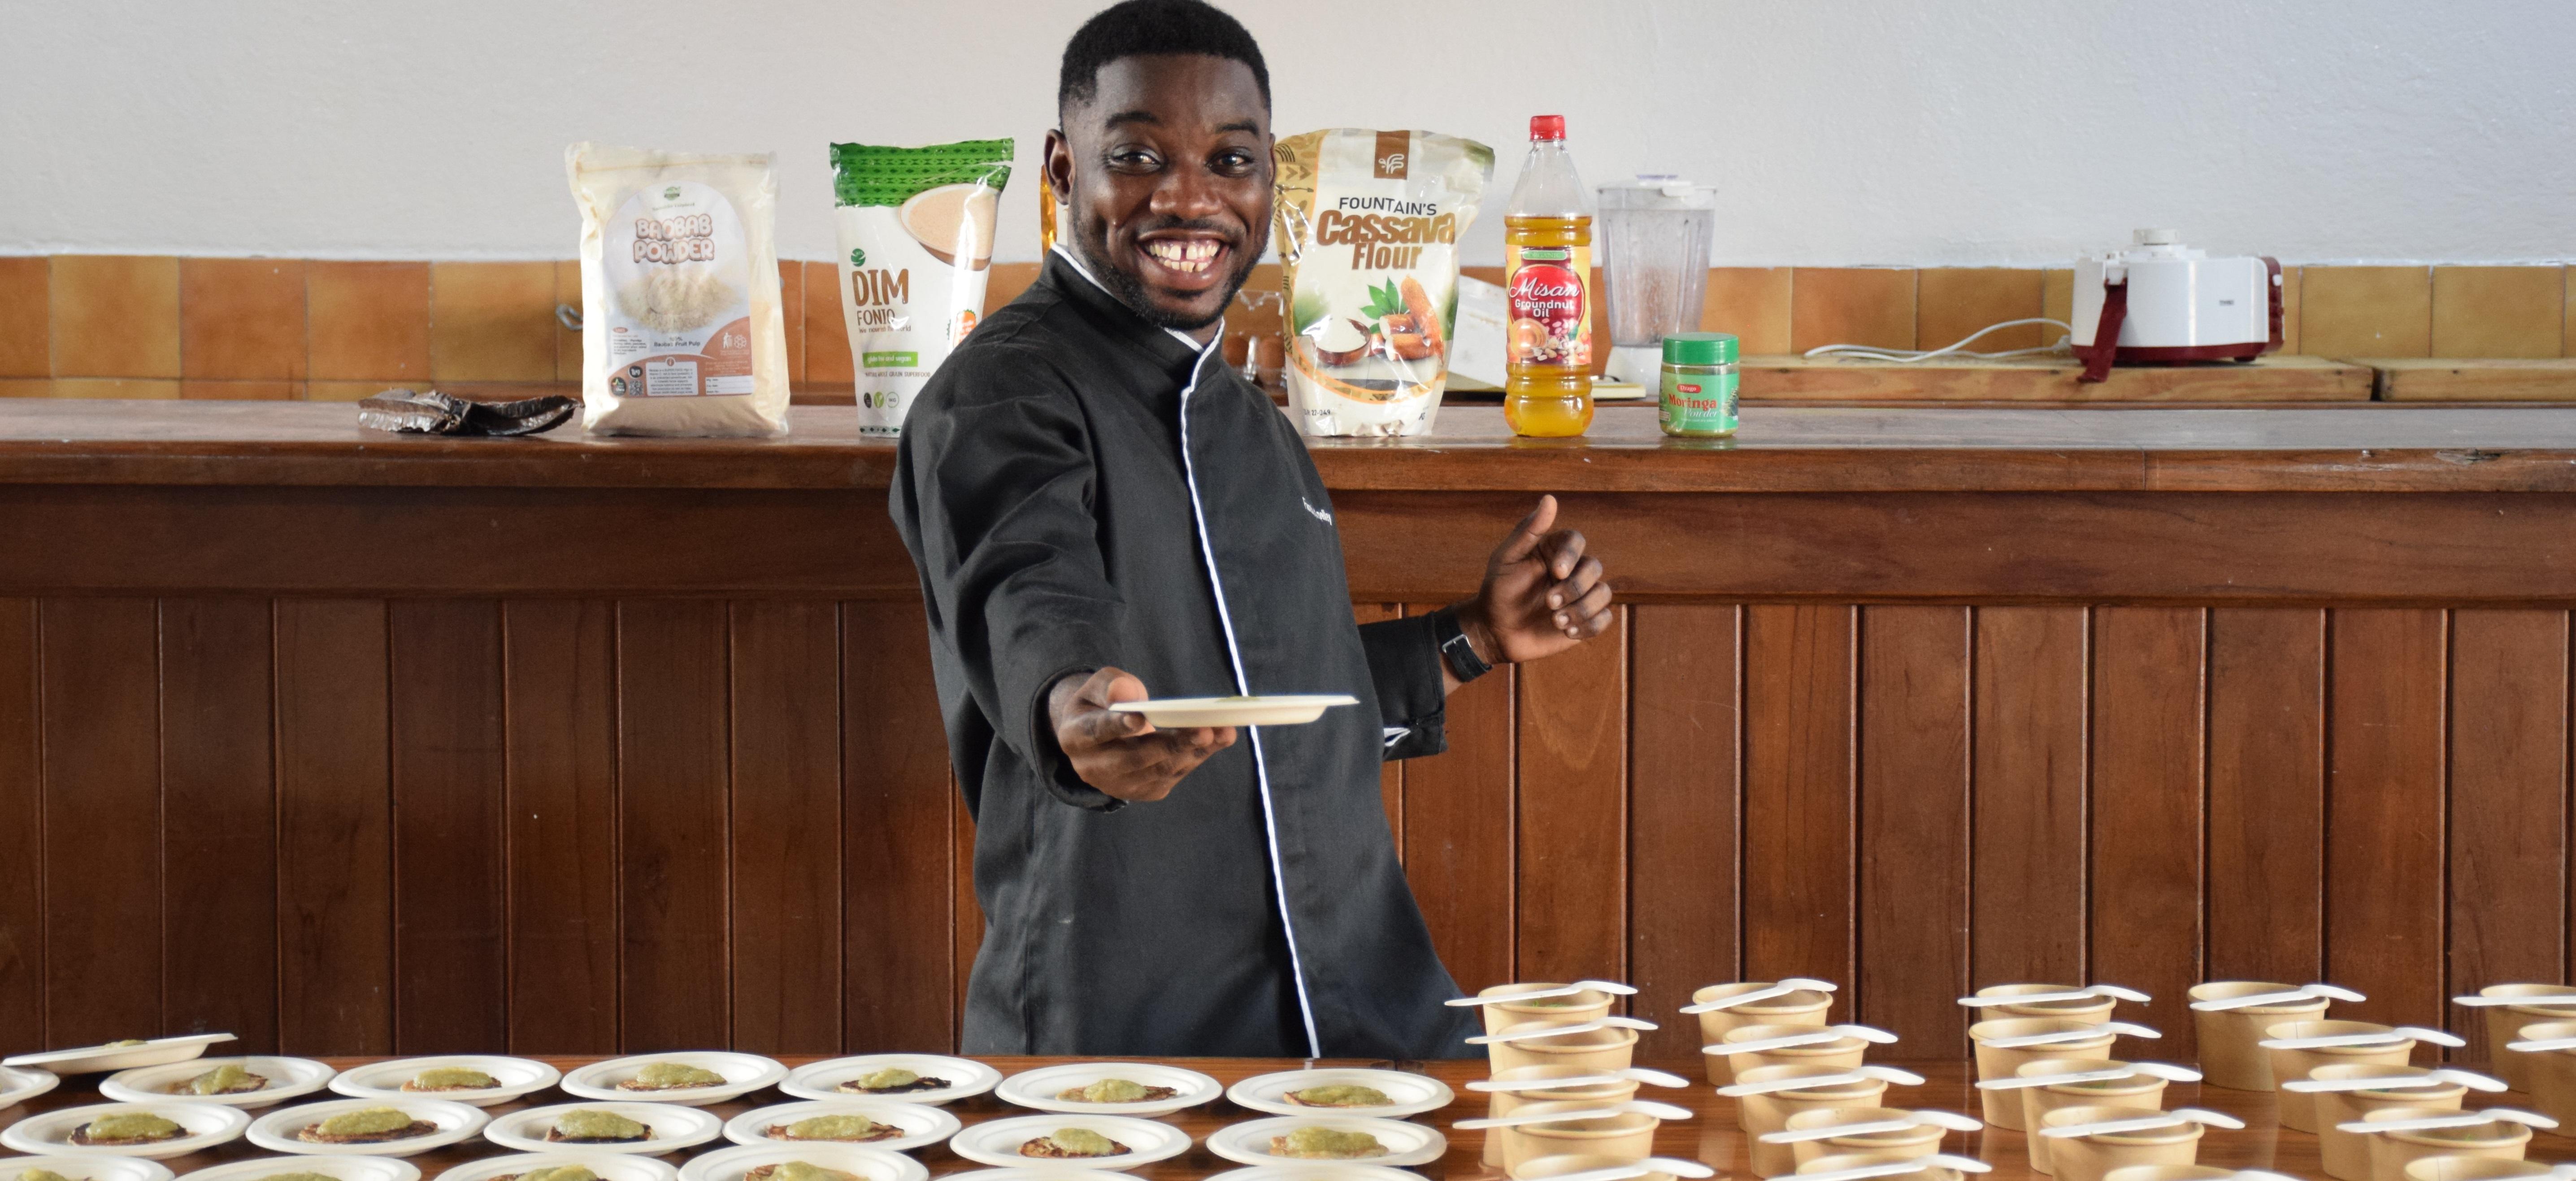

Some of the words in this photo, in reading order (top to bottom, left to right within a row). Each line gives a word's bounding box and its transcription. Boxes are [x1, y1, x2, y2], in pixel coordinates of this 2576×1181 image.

[1339, 197, 1437, 215] FOUNTAIN'S
[635, 214, 713, 241] BAOBAB
[1316, 209, 1455, 246] Cassava
[633, 238, 715, 265] POWDER
[1352, 242, 1422, 270] Flour
[852, 269, 909, 306] DIM
[1509, 277, 1580, 301] Misan
[1515, 299, 1575, 309] Groundnut
[1533, 309, 1550, 317] Oil
[857, 309, 895, 326] FONIO
[1668, 394, 1717, 411] Moringa
